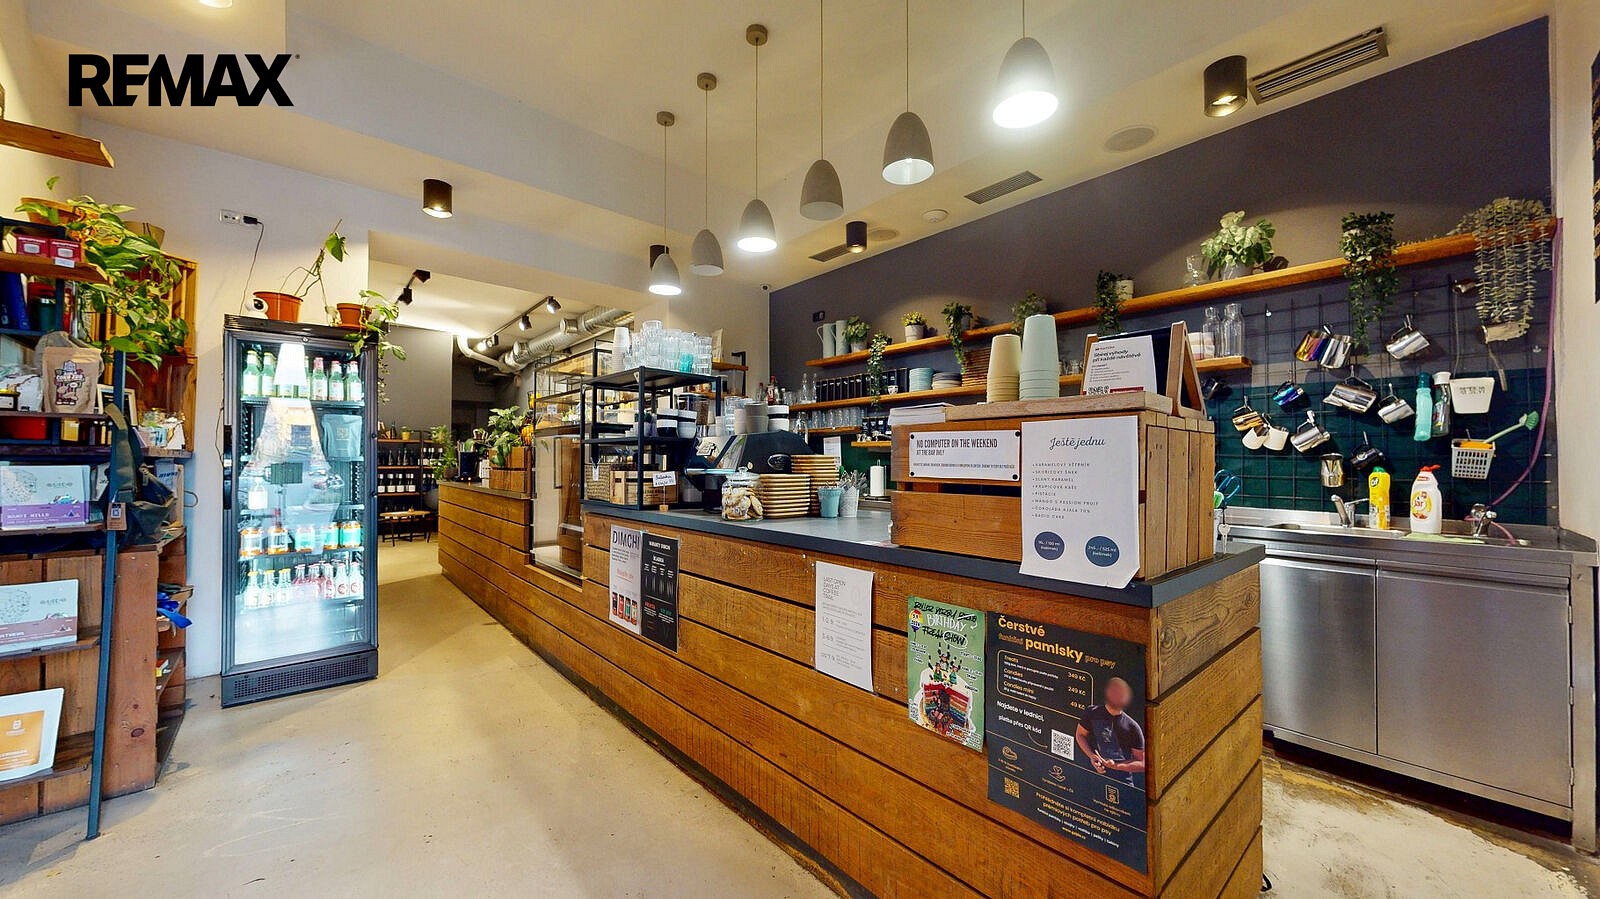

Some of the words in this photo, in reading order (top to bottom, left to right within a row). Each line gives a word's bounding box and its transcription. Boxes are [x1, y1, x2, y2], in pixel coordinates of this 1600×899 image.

[916, 439, 924, 448] NO
[924, 439, 950, 448] COMPUTER
[951, 439, 959, 448] ON
[960, 438, 970, 448] THE
[971, 438, 998, 448] WEEKEND
[926, 614, 967, 631] BIRTHDAY
[998, 615, 1046, 637] Čerstvé
[1025, 638, 1084, 664] pamlsky
[996, 700, 1019, 713] Najdete
[1024, 723, 1032, 731] QR
